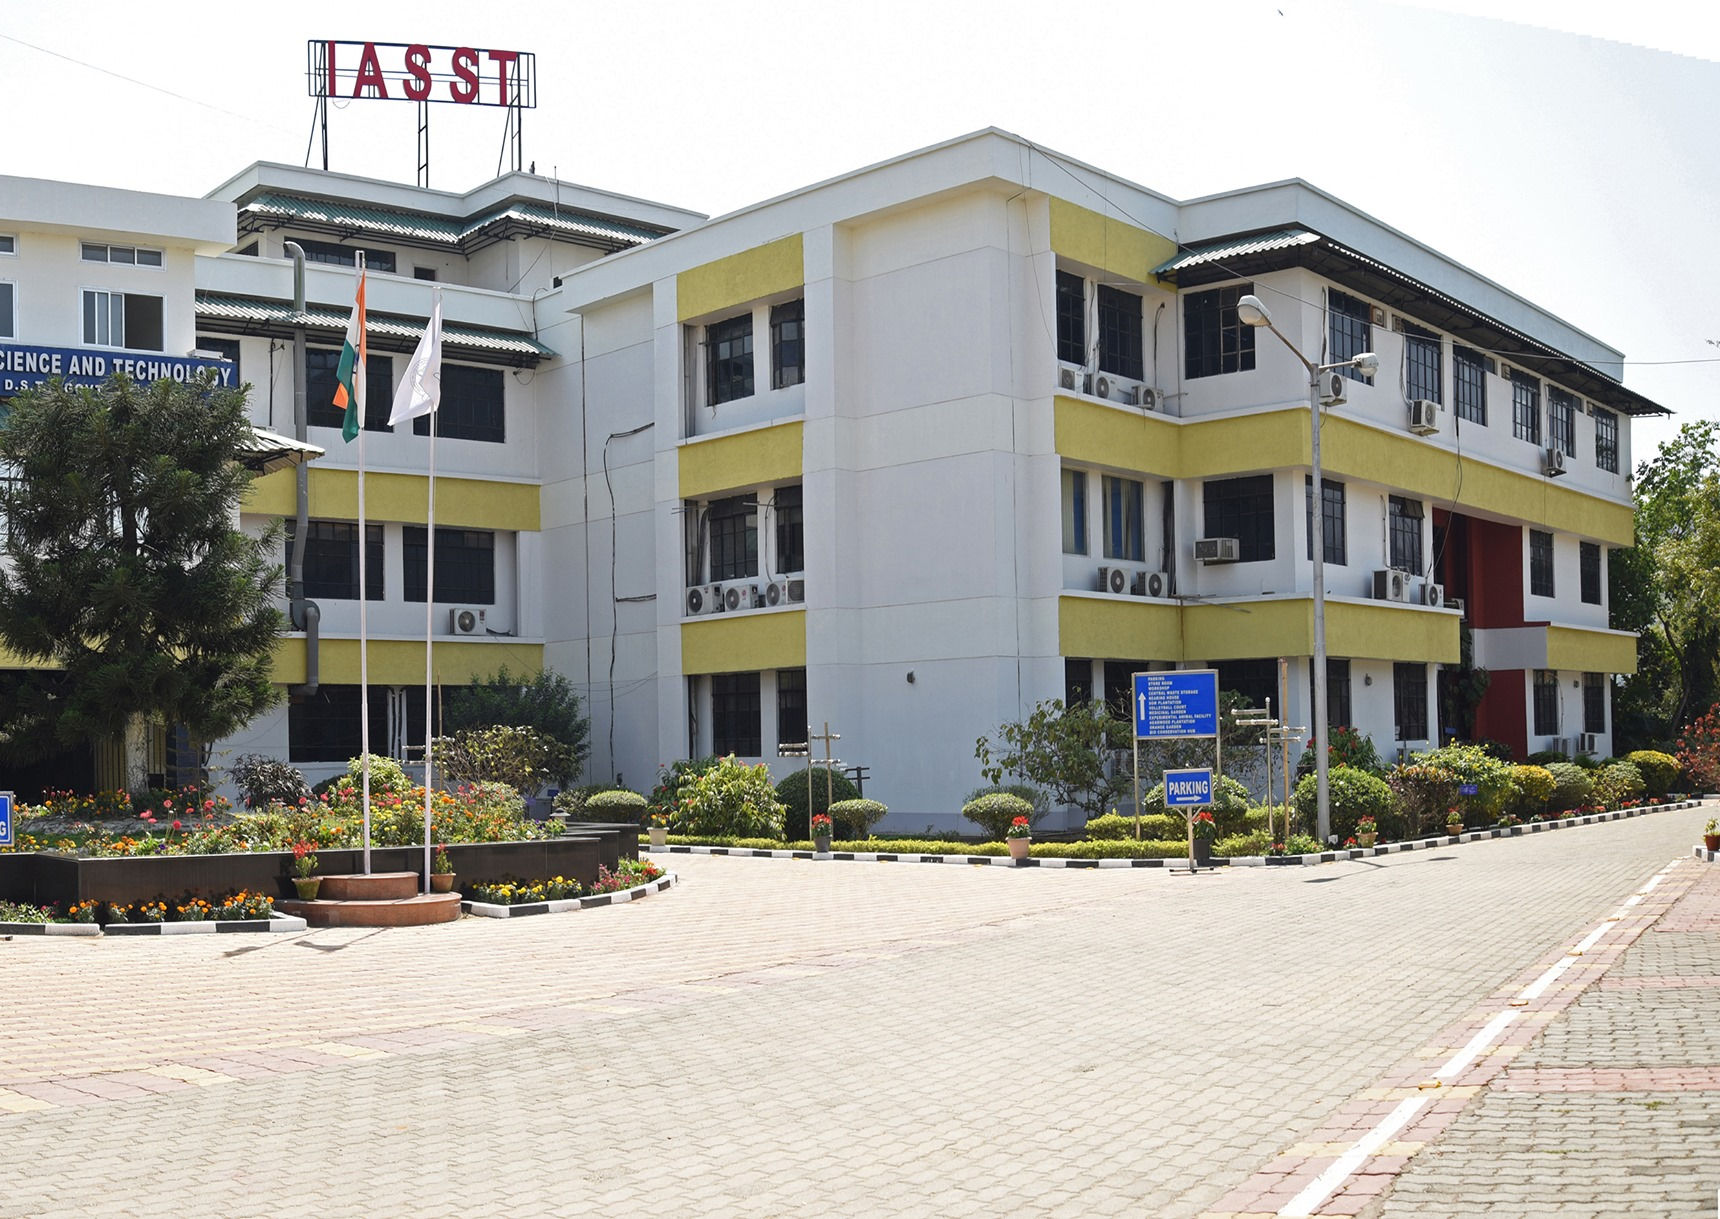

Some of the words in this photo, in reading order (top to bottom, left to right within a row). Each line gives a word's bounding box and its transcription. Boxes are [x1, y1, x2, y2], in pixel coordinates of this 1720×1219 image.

[328, 40, 519, 107] IASST
[69, 355, 106, 377] AND
[1168, 780, 1209, 796] PARKING
